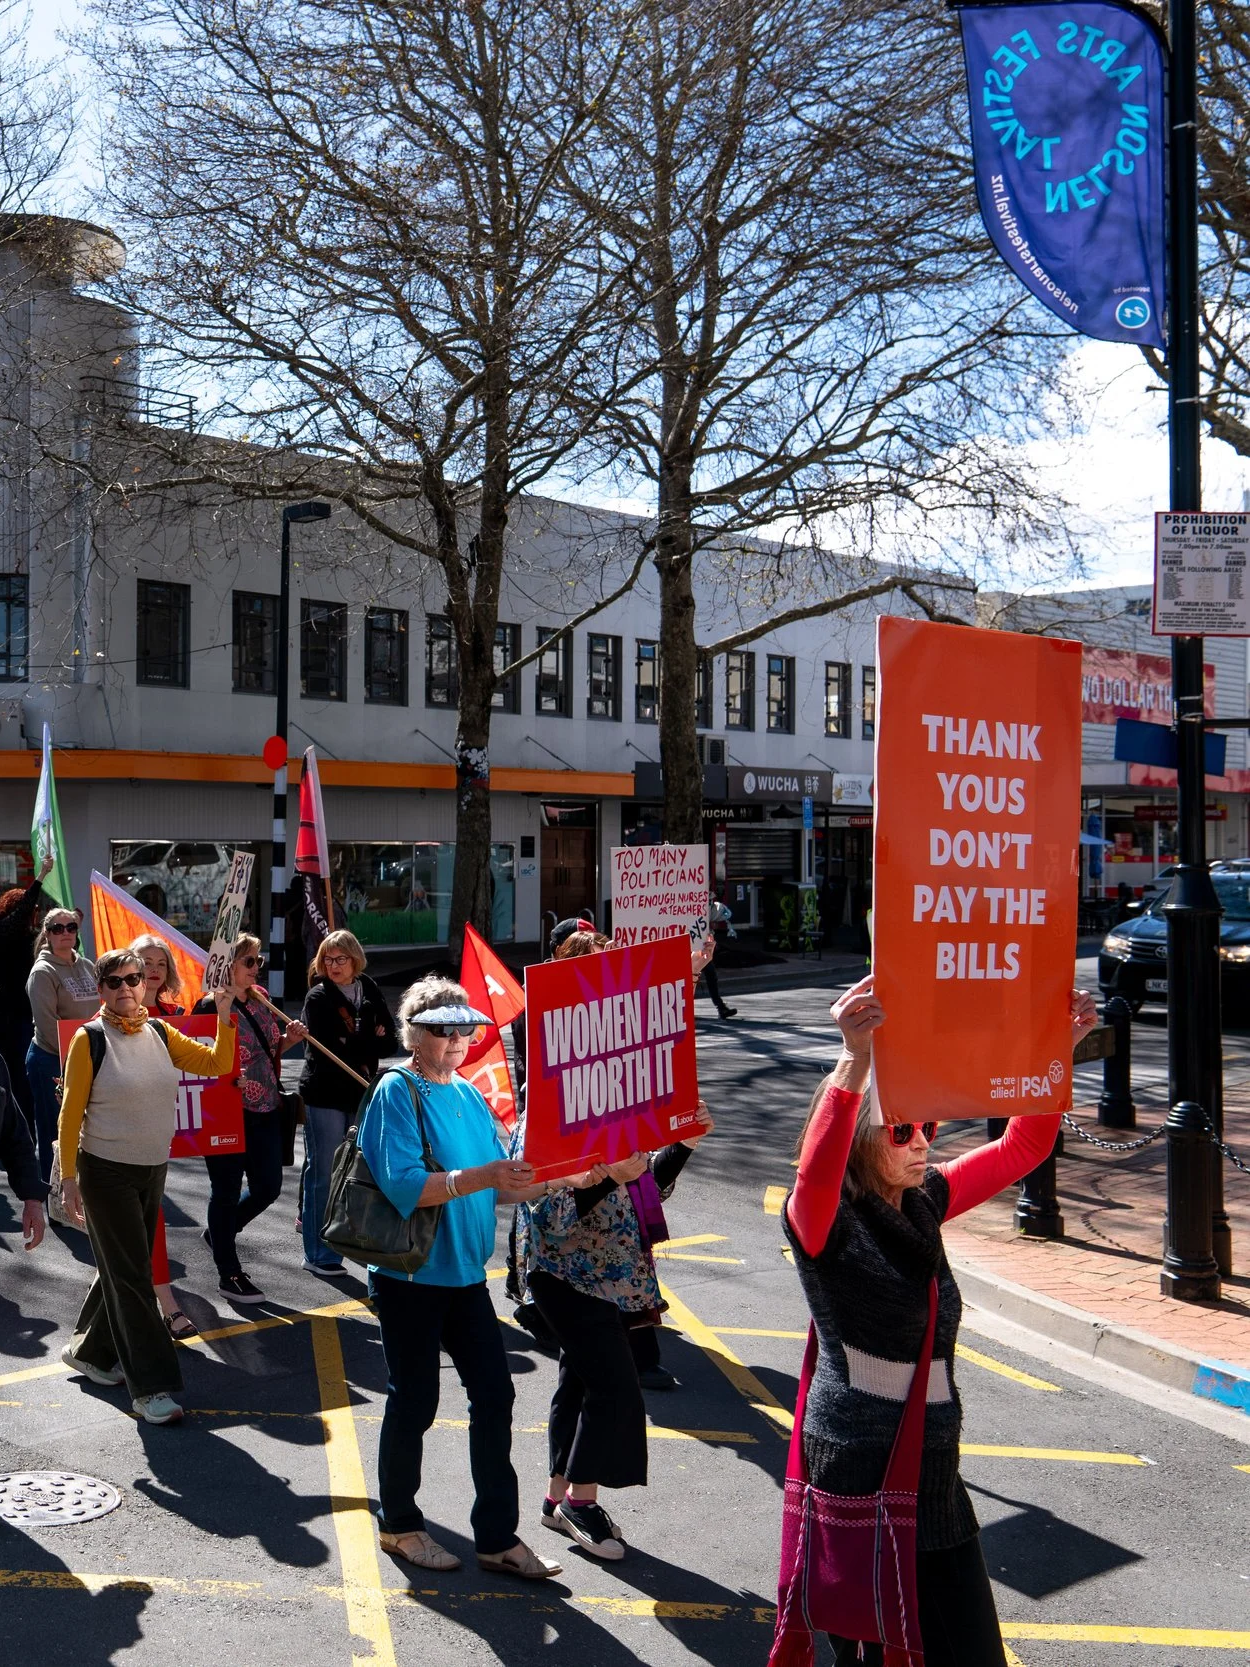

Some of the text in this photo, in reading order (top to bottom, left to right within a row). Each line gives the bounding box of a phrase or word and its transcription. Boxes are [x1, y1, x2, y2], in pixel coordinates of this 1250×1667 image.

[1164, 515, 1247, 525] PROHIBITION
[1172, 526, 1239, 536] OF LIQUOR
[1103, 677, 1155, 710] DOLLAR
[921, 713, 1043, 762] THANK
[758, 775, 799, 792] WUCHA
[936, 772, 1026, 816] YOUS
[615, 848, 687, 870] TOO MANY
[929, 828, 1032, 870] DON'T
[620, 865, 704, 891] POLITICIANS
[615, 891, 708, 910] NOT ENOUGH NURSES
[658, 904, 707, 917] OR TEACHERS
[913, 884, 1046, 925] PAY THE
[615, 927, 637, 947] PAY
[935, 942, 1021, 981] BILLS
[543, 979, 687, 1067] WOMEN ARE
[562, 1040, 674, 1124] WORTH IT
[990, 1076, 1016, 1085] we are
[1021, 1075, 1052, 1098] PSA
[990, 1088, 1015, 1099] allied
[678, 1113, 694, 1126] Labour
